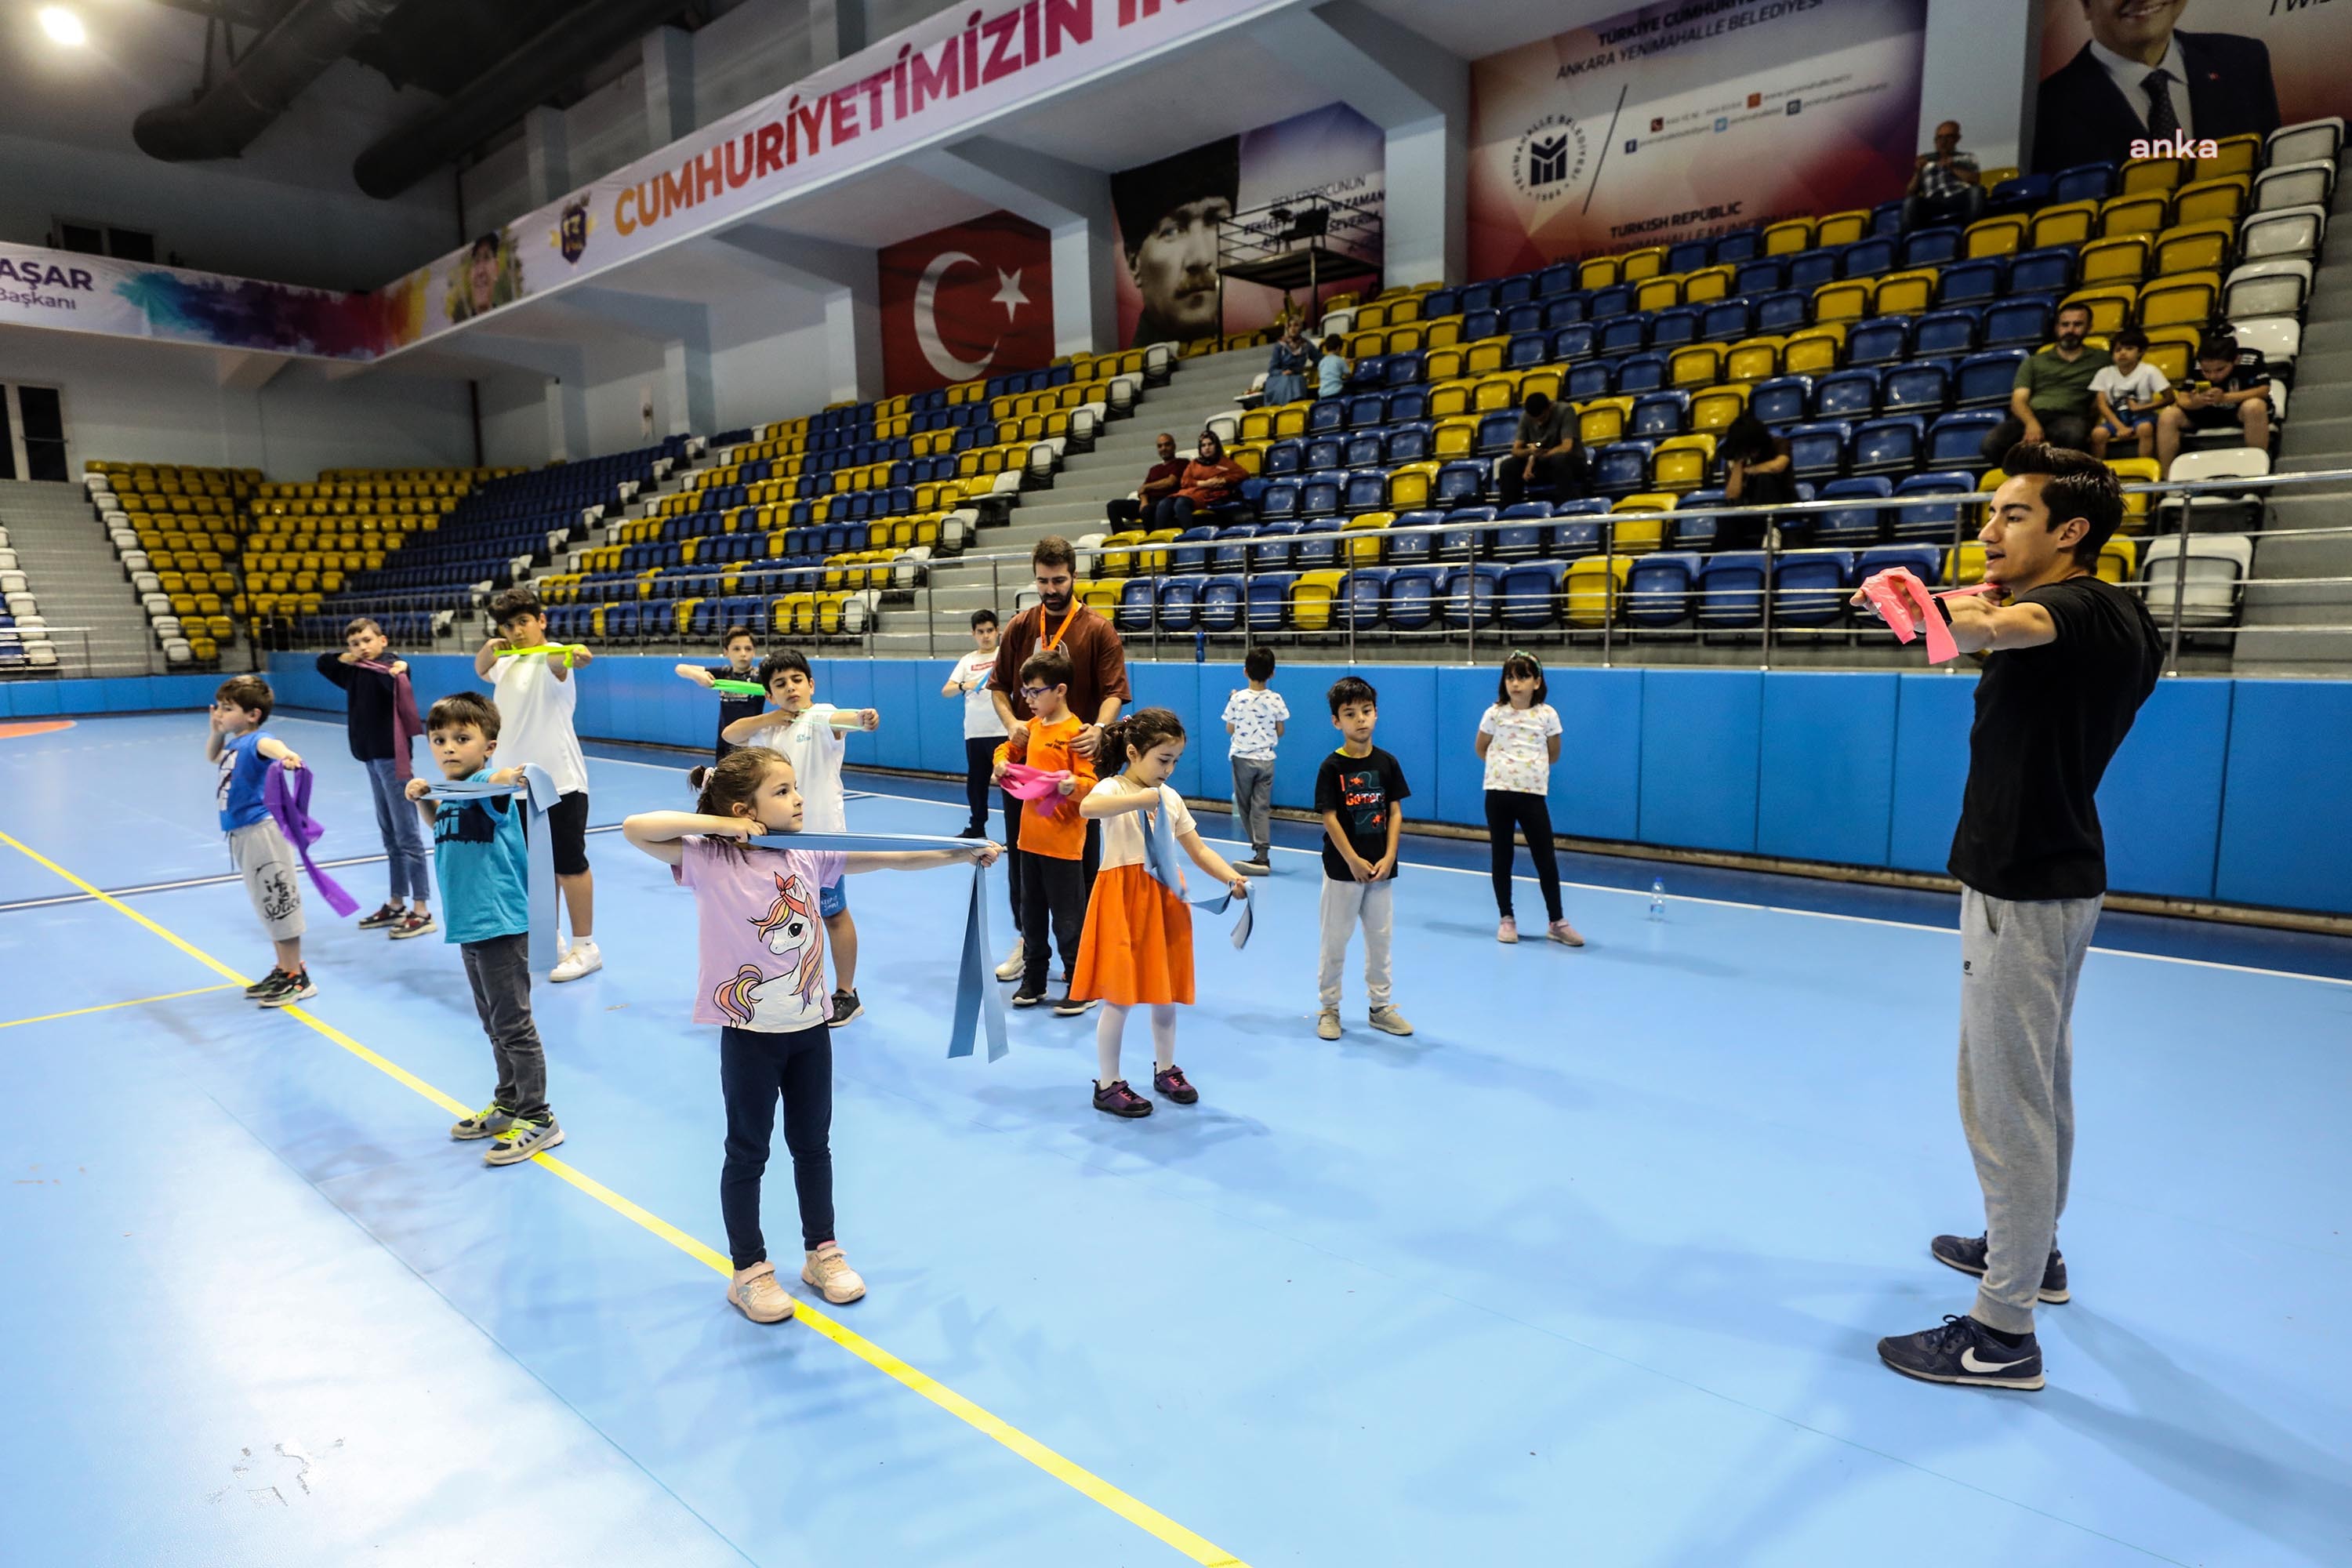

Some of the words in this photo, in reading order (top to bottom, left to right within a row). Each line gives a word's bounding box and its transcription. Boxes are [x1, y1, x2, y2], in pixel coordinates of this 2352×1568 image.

[1556, 51, 1616, 79] ANKARA
[1727, 0, 1824, 31] BELEDİYES
[615, 0, 1093, 236] CUMHURİYETİMİZİN
[1610, 215, 1670, 239] TURKISH
[1671, 200, 1743, 227] REPUBLIC
